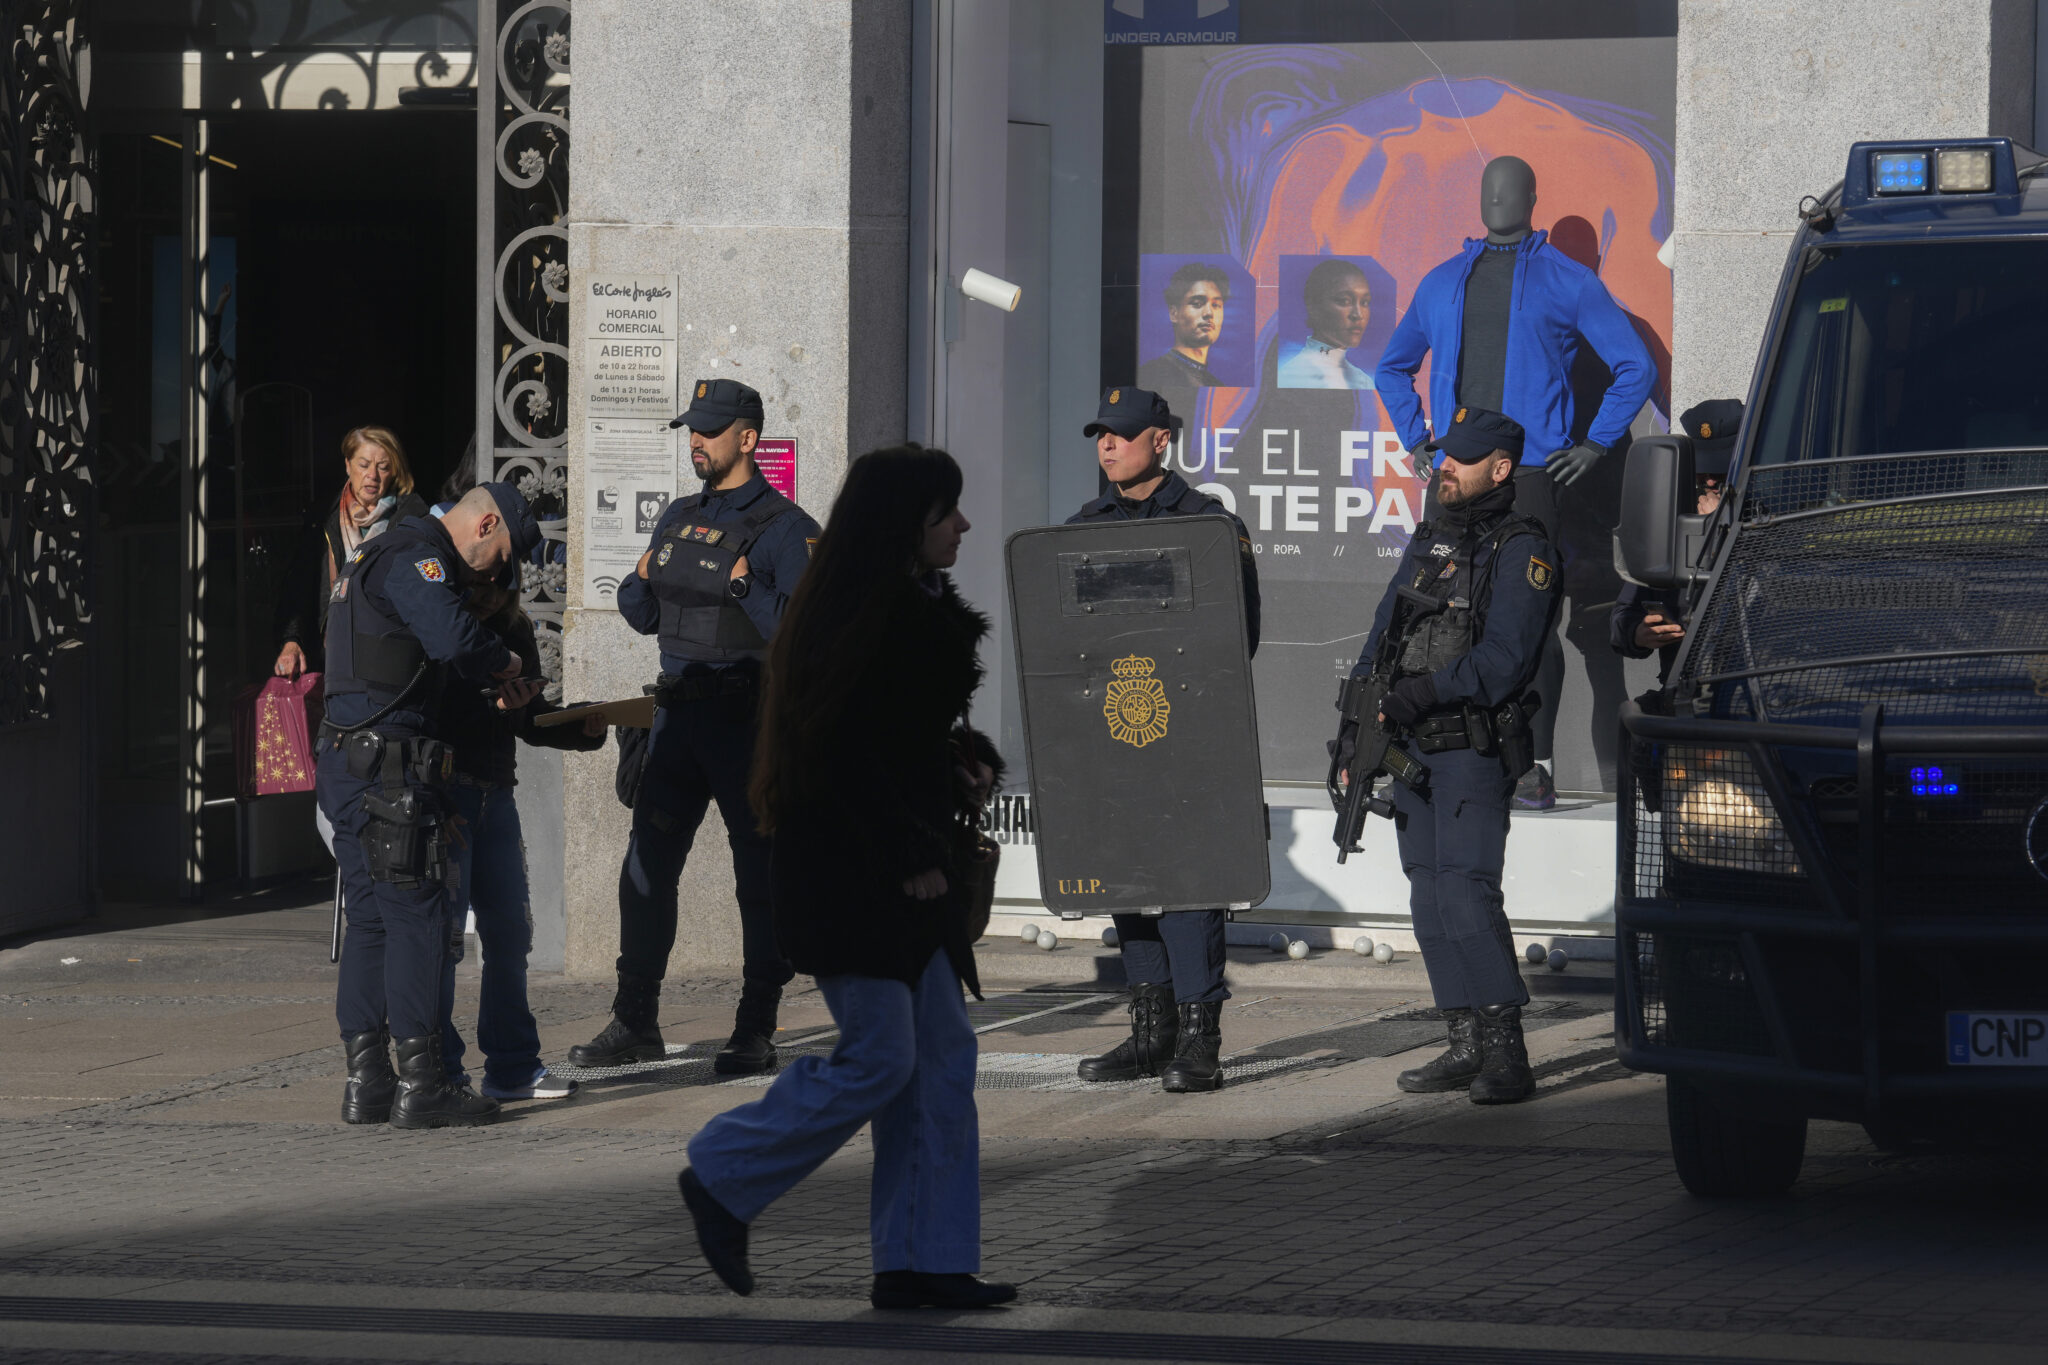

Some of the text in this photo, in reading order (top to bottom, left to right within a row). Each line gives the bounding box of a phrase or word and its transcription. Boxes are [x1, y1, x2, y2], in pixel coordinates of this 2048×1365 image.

[1104, 31, 1237, 44] UNDER ARMOUR
[592, 282, 604, 296] El
[604, 283, 632, 297] Corte
[606, 309, 657, 320] HORARIO
[598, 322, 665, 334] COMERCIAL
[600, 344, 662, 358] ABIERTO
[599, 362, 609, 370] de
[611, 362, 620, 370] 10
[627, 362, 637, 370] 22
[638, 362, 661, 371] horas
[593, 372, 604, 380] de
[605, 373, 628, 381] Lunes
[636, 373, 666, 381] Sábado
[611, 386, 620, 394] 11
[628, 386, 637, 394] 21
[639, 386, 661, 395] horas
[590, 394, 629, 405] Domingos
[630, 396, 636, 405] y
[1262, 428, 1319, 476] EL
[1340, 428, 1423, 478] FR
[1249, 484, 1319, 532] TE
[1334, 486, 1428, 535] PA
[1252, 543, 1263, 555] IO
[1273, 543, 1301, 555] ROPA
[1058, 879, 1107, 895] U.I.P.
[1970, 1018, 2046, 1058] CNP
[1954, 1044, 1966, 1056] E
